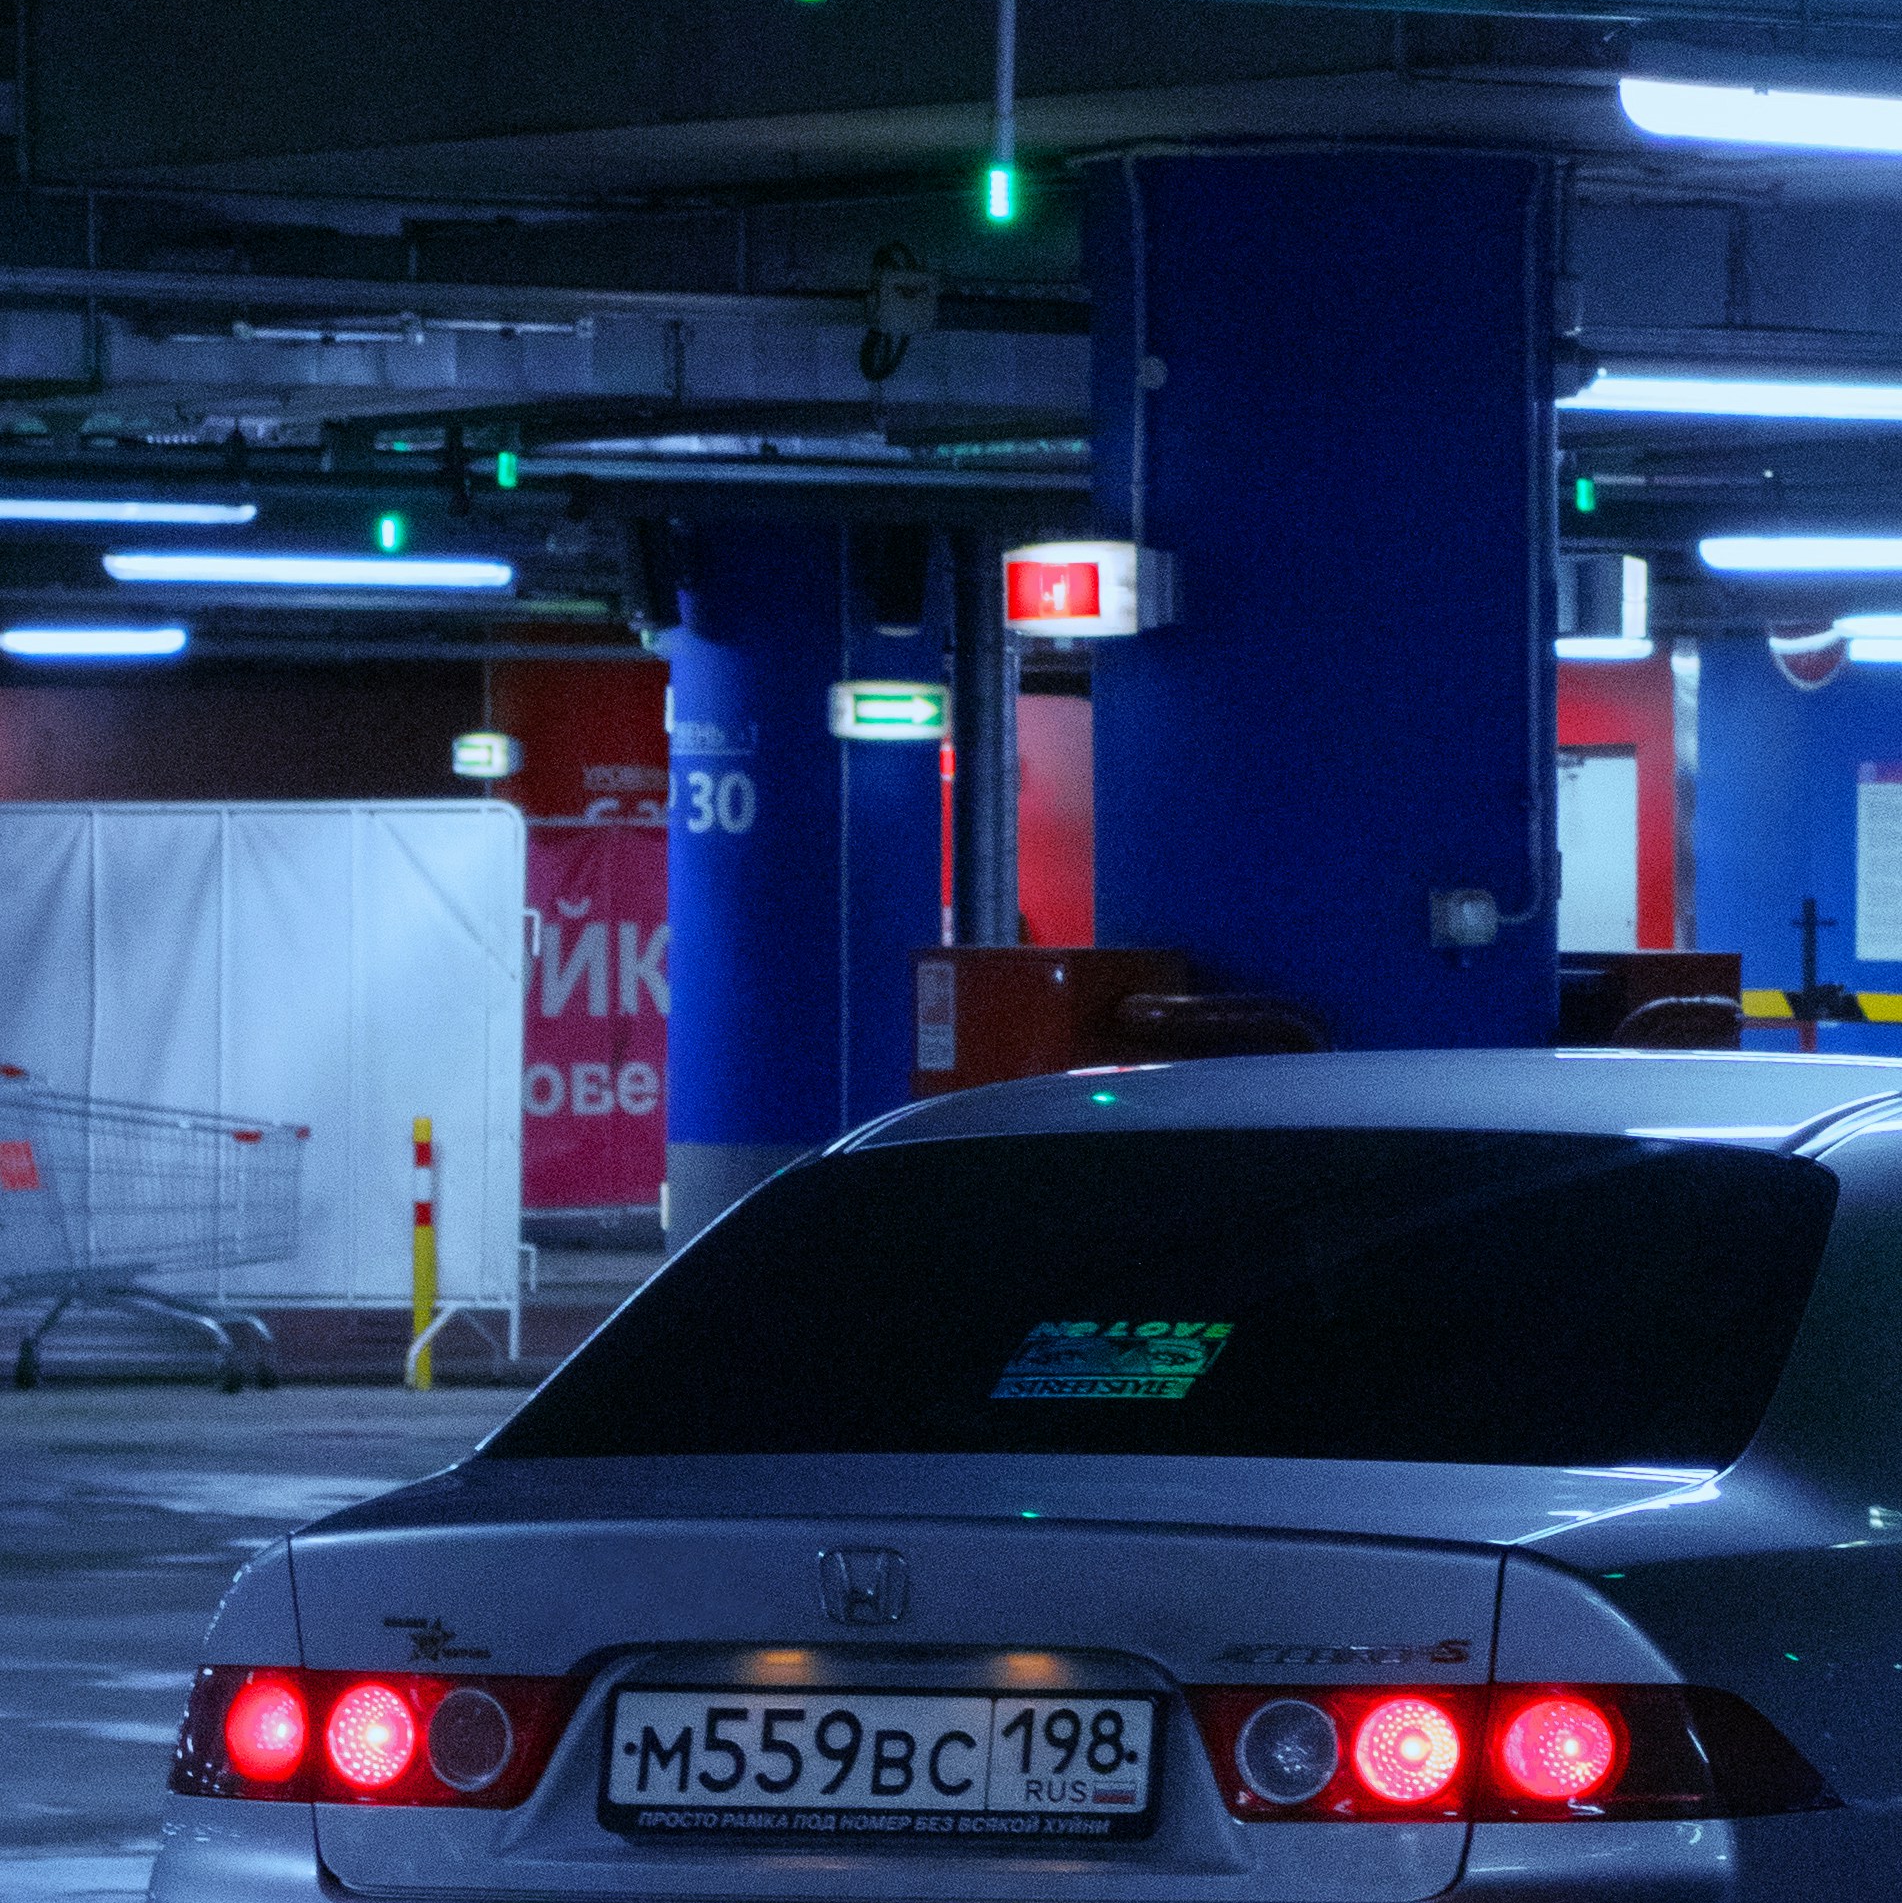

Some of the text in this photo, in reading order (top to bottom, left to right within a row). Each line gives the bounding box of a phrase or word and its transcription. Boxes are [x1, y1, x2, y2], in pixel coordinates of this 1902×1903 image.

[686, 771, 757, 835] 30
[1103, 1321, 1235, 1338] LOVE
[636, 1707, 1125, 1796] М559ВС 198
[1025, 1779, 1087, 1803] RUS
[638, 1811, 719, 1828] ПРОСТО
[721, 1812, 789, 1829] РАМКА
[793, 1813, 837, 1832] ПОД
[839, 1814, 912, 1831] НОМЕР
[914, 1815, 955, 1832] БЕЗ
[957, 1815, 1041, 1834] ВСЯКОЙ
